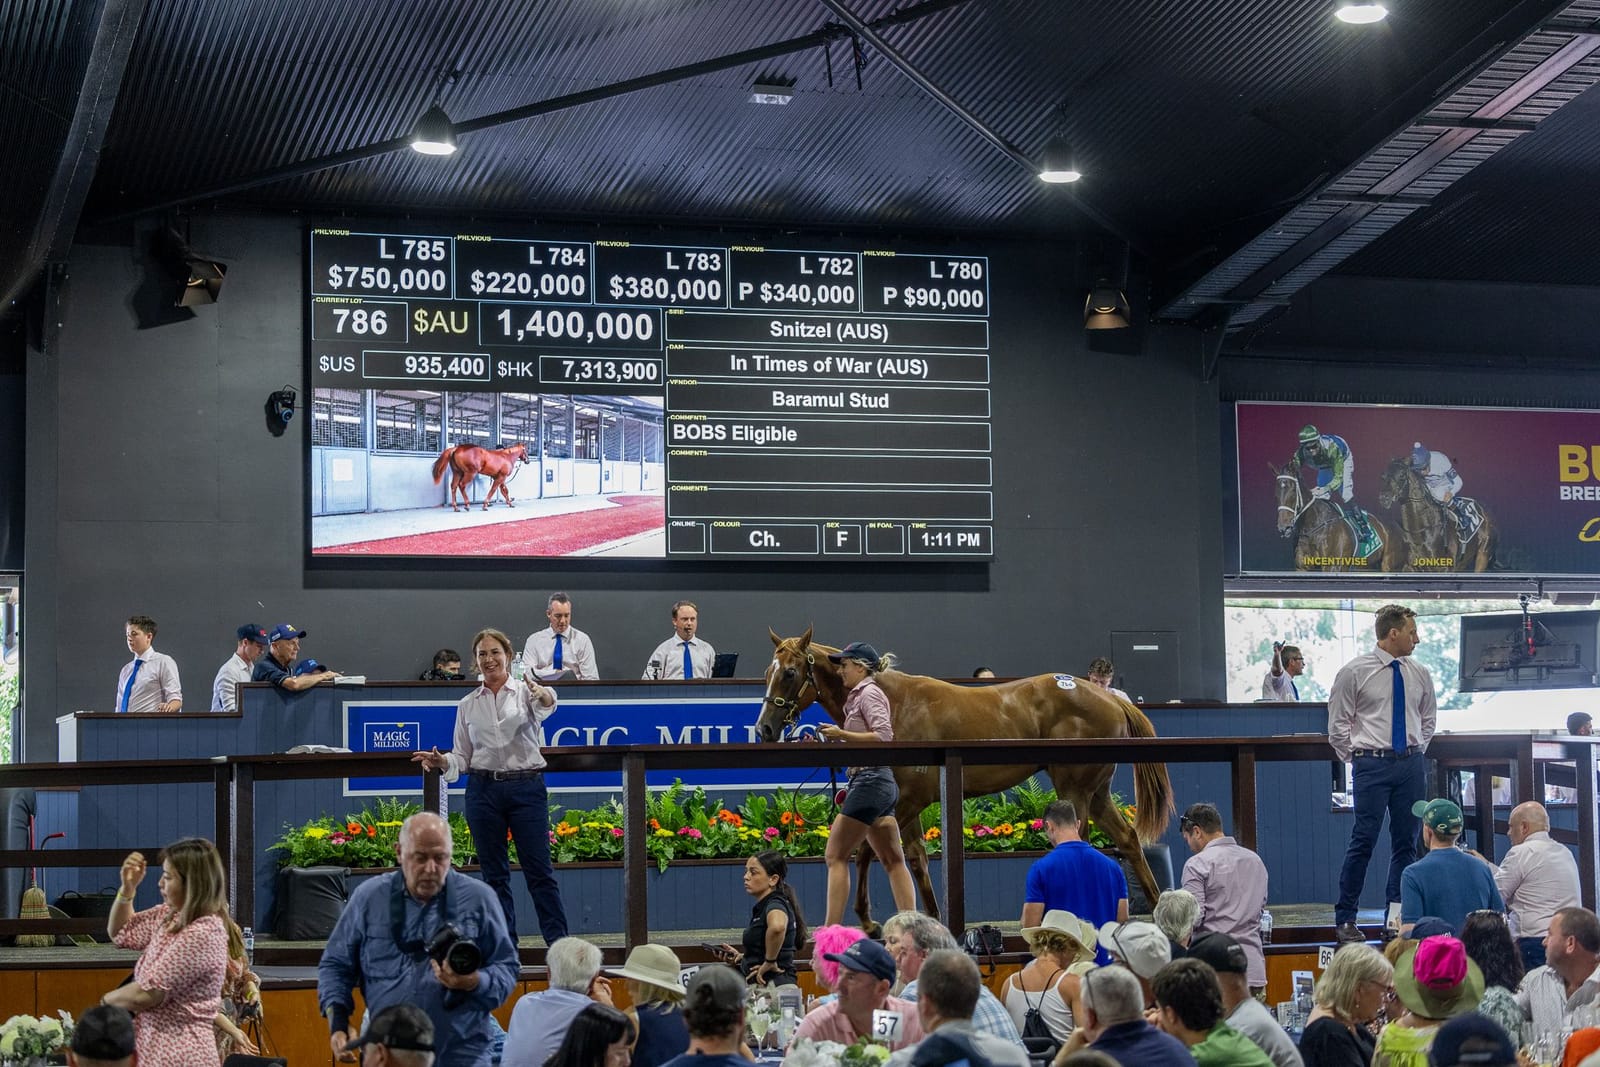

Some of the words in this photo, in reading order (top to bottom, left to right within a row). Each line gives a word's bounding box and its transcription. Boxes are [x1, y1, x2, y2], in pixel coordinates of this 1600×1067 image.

[380, 238, 395, 260] L
[402, 239, 446, 261] 785
[529, 246, 543, 265] L
[548, 247, 586, 267] 784
[666, 252, 680, 270] L
[685, 253, 721, 272] 783
[800, 256, 813, 275] L
[818, 257, 854, 276] 782
[930, 261, 943, 279] L
[947, 262, 983, 280] 780
[328, 263, 447, 293] $750,000
[470, 269, 586, 297] $220,000
[609, 274, 721, 302] $380,000
[739, 282, 754, 301] P
[759, 281, 855, 306] $340,000
[883, 286, 898, 305] P
[903, 286, 984, 310] $90,000
[332, 308, 388, 336] 786
[413, 308, 469, 335] $AU
[497, 308, 654, 343] 1,400,000
[769, 320, 832, 339] Snitzel
[836, 322, 889, 343] (AUS)
[318, 355, 356, 373] $US
[404, 355, 485, 378] 935,400
[497, 360, 534, 378] $HK
[562, 359, 658, 383] 7,313,900
[730, 354, 747, 371] In
[752, 355, 809, 373] Times
[813, 355, 833, 373] of
[836, 357, 873, 374] War
[876, 358, 930, 378] (AUS)
[772, 390, 845, 409] Baramul
[849, 392, 890, 410] Stud
[672, 423, 727, 441] BOBS
[731, 425, 798, 444] Eligible
[749, 530, 781, 547] Ch.
[836, 531, 849, 547] F
[921, 532, 952, 547] 1:11
[957, 532, 980, 547] PM
[1303, 556, 1369, 566] INCENTIVISE
[1413, 556, 1454, 567] JONKER
[373, 731, 411, 741] MAGIC
[373, 740, 411, 748] MILLIONS
[878, 1015, 899, 1036] 57
